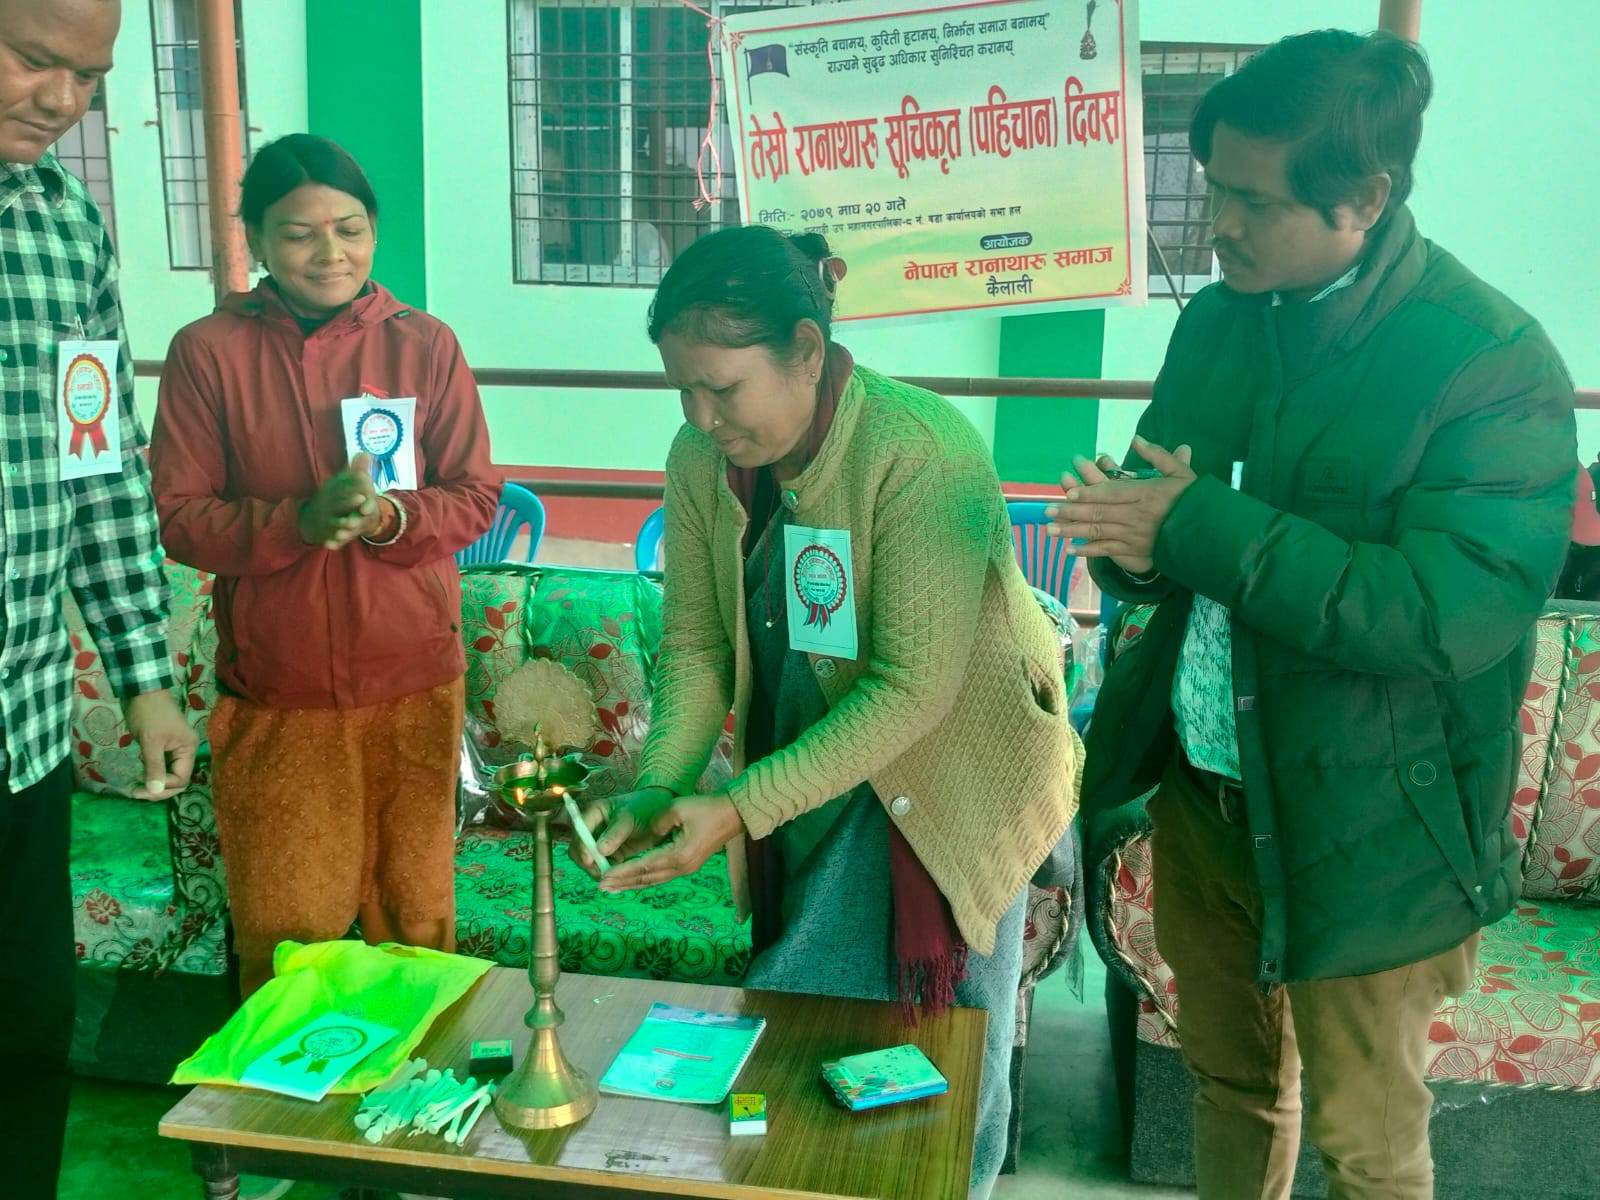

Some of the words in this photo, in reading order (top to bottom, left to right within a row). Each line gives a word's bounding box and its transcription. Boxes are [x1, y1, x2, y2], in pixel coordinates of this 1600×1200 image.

[978, 20, 1008, 34] समाज
[889, 49, 927, 67] अधिकार
[930, 43, 974, 66] सुनिश्चित
[884, 95, 961, 179] सूचिकृत
[969, 84, 1058, 158] (पहिचान)
[1065, 76, 1120, 147] दिवस
[801, 207, 833, 221] २०७९
[838, 203, 861, 216] माघ
[865, 202, 881, 216] २०
[886, 196, 907, 211] गते
[983, 235, 1031, 249] आयोजक
[904, 260, 958, 281] नेपाल
[1053, 246, 1113, 268] समाज
[986, 273, 1033, 297] कैलाली
